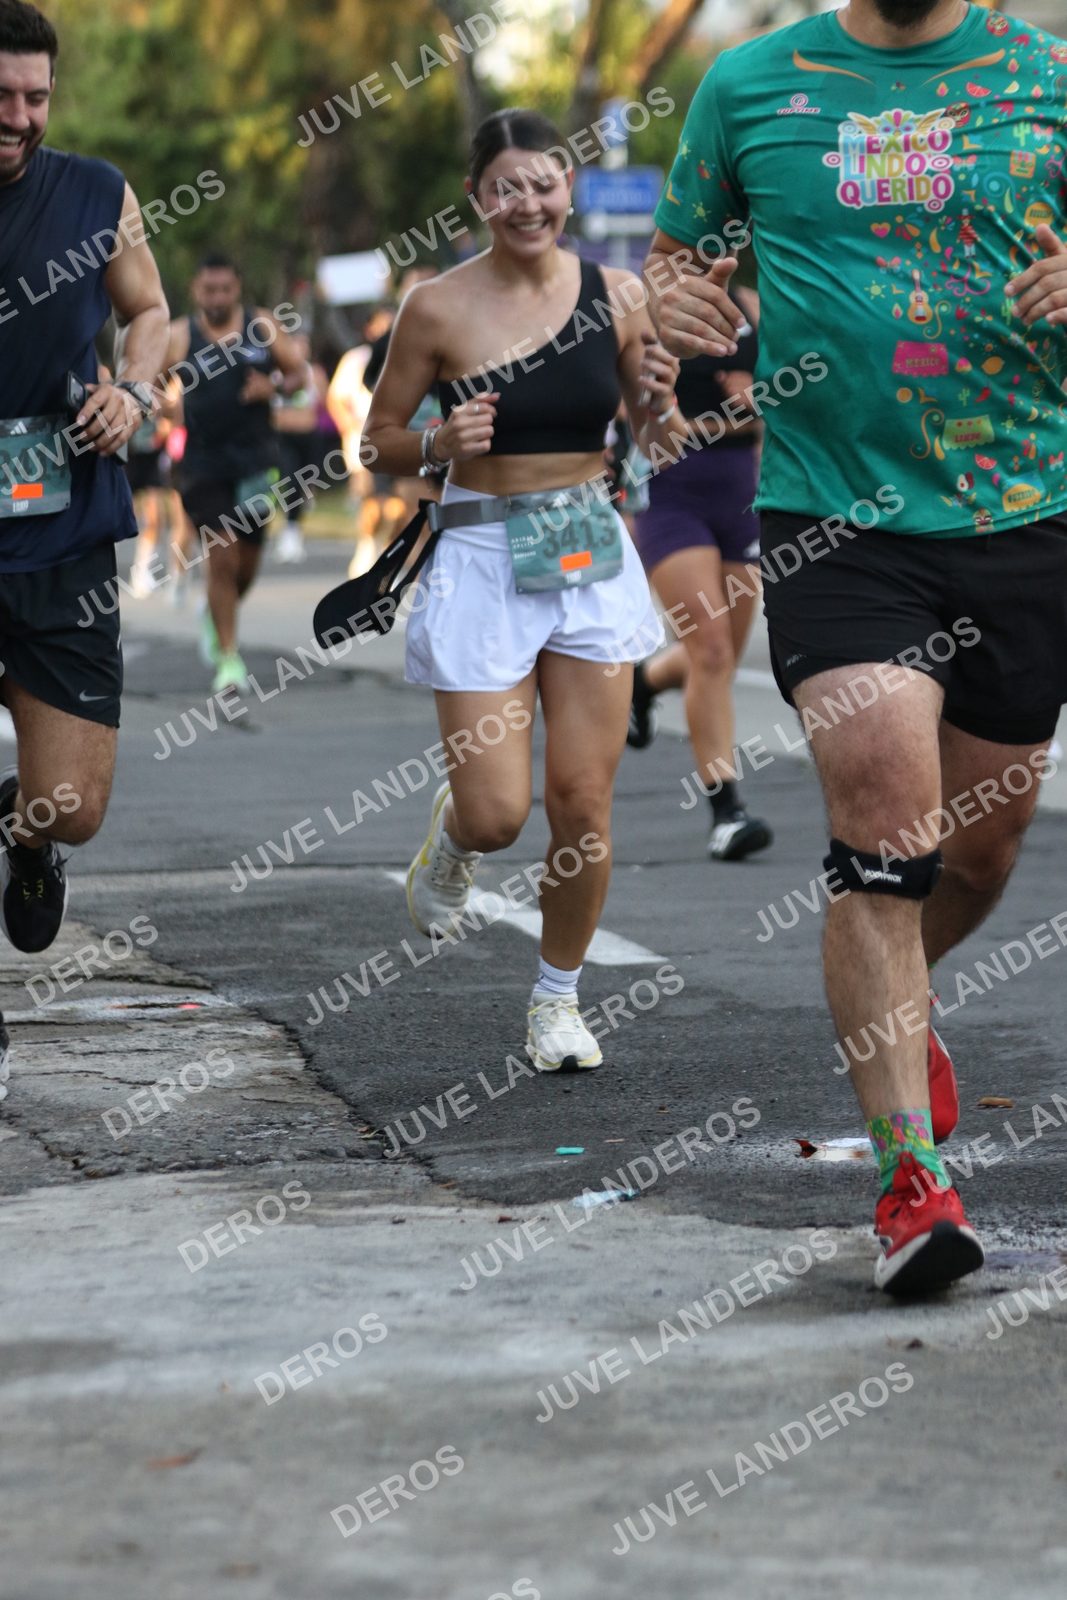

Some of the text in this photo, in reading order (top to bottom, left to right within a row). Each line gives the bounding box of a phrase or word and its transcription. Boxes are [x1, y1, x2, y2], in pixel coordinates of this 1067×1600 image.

[845, 153, 926, 180] LINDO
[840, 175, 952, 207] QUERIDO
[543, 511, 617, 559] 3413
